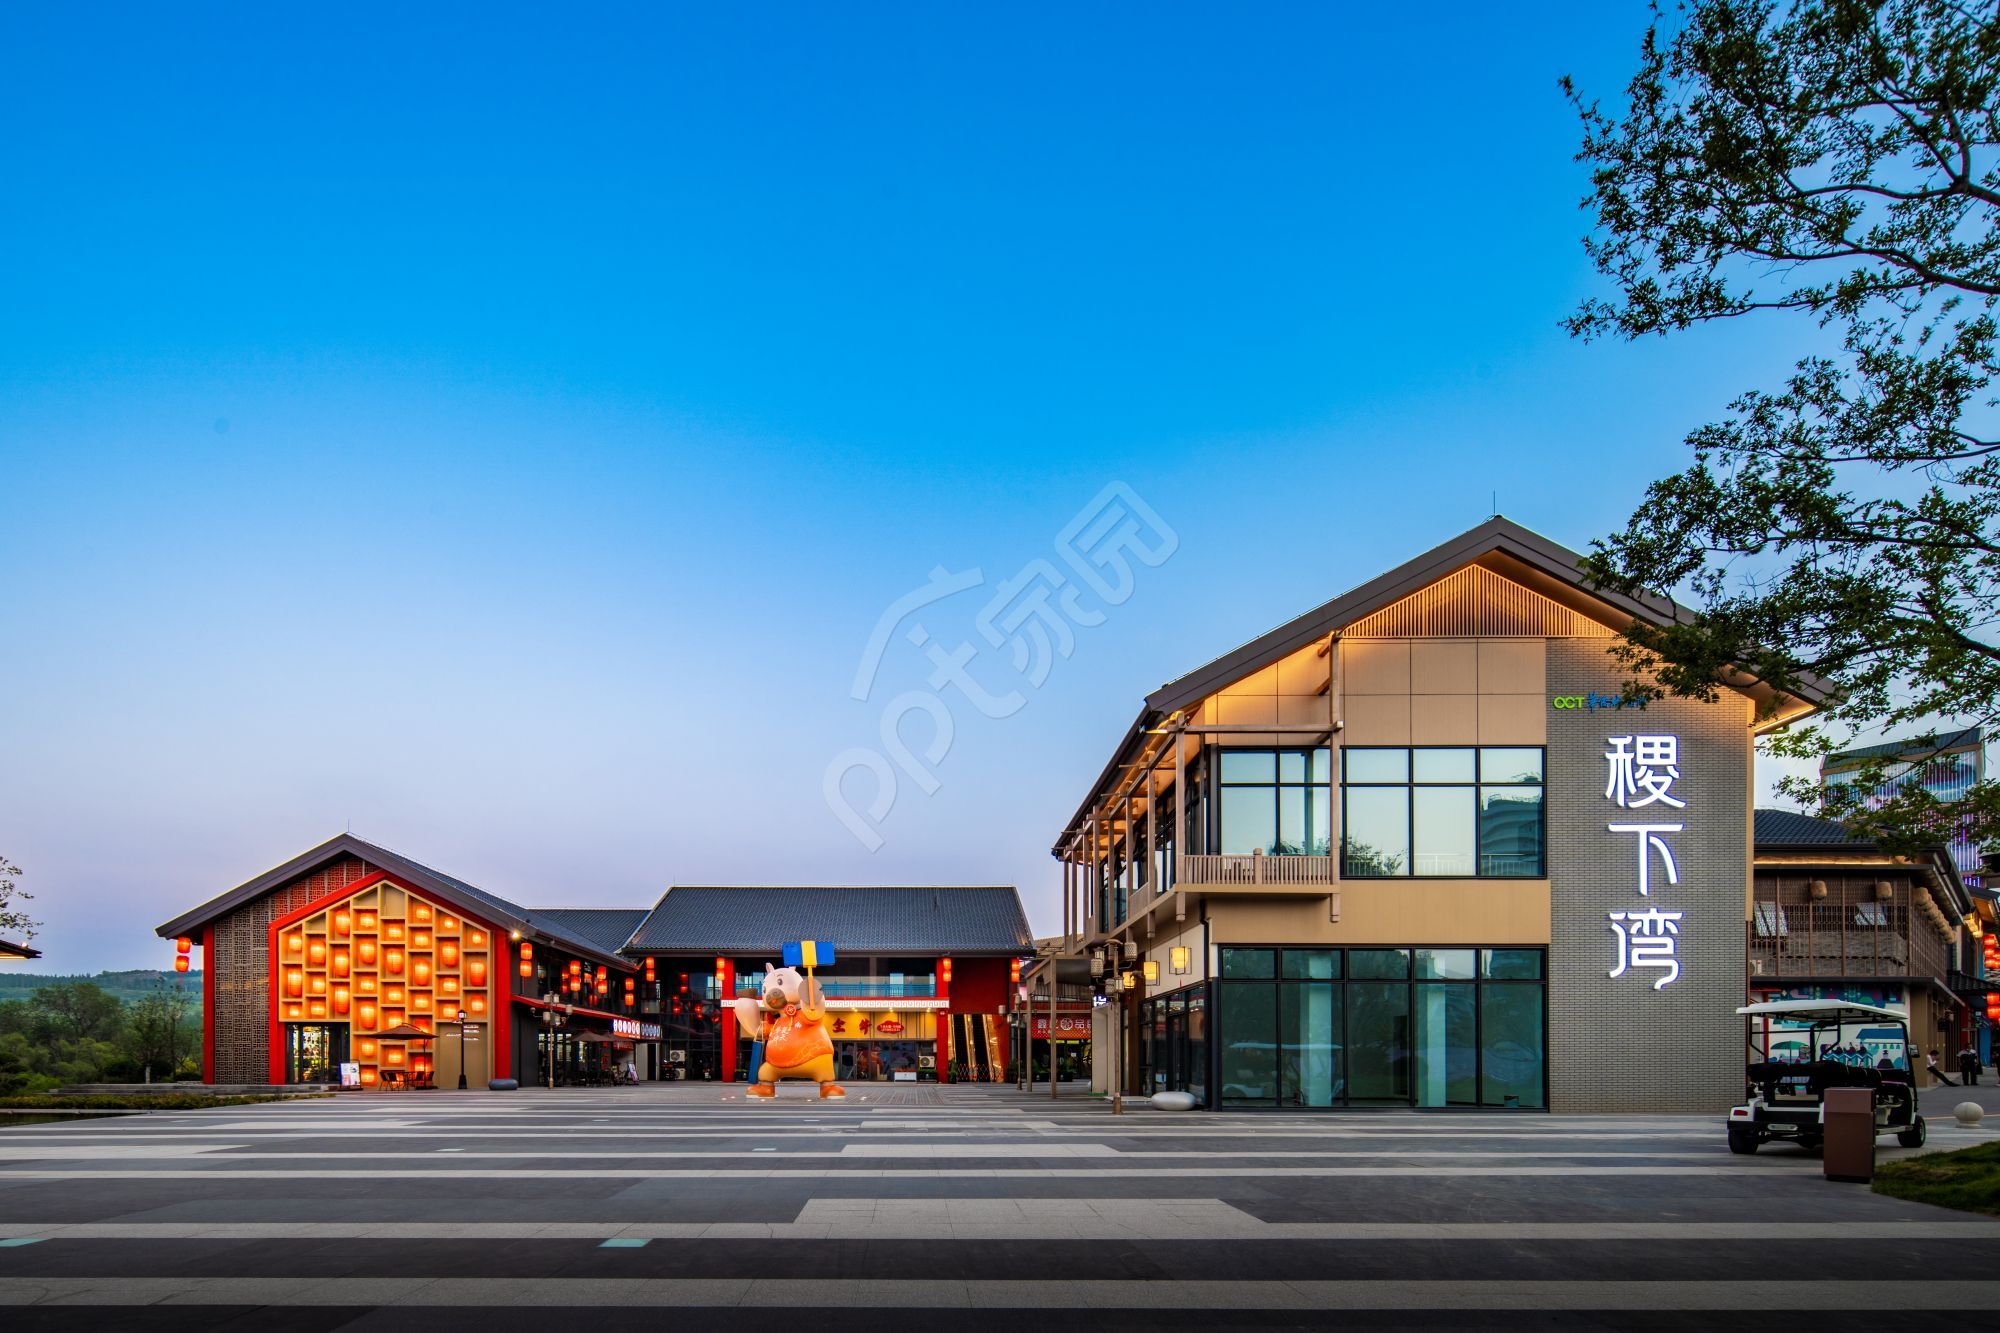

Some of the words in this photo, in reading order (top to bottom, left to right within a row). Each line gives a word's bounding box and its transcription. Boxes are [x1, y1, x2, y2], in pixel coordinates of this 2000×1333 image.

[1553, 696, 1585, 709] OCT
[1605, 735, 1687, 990] 稷下湾
